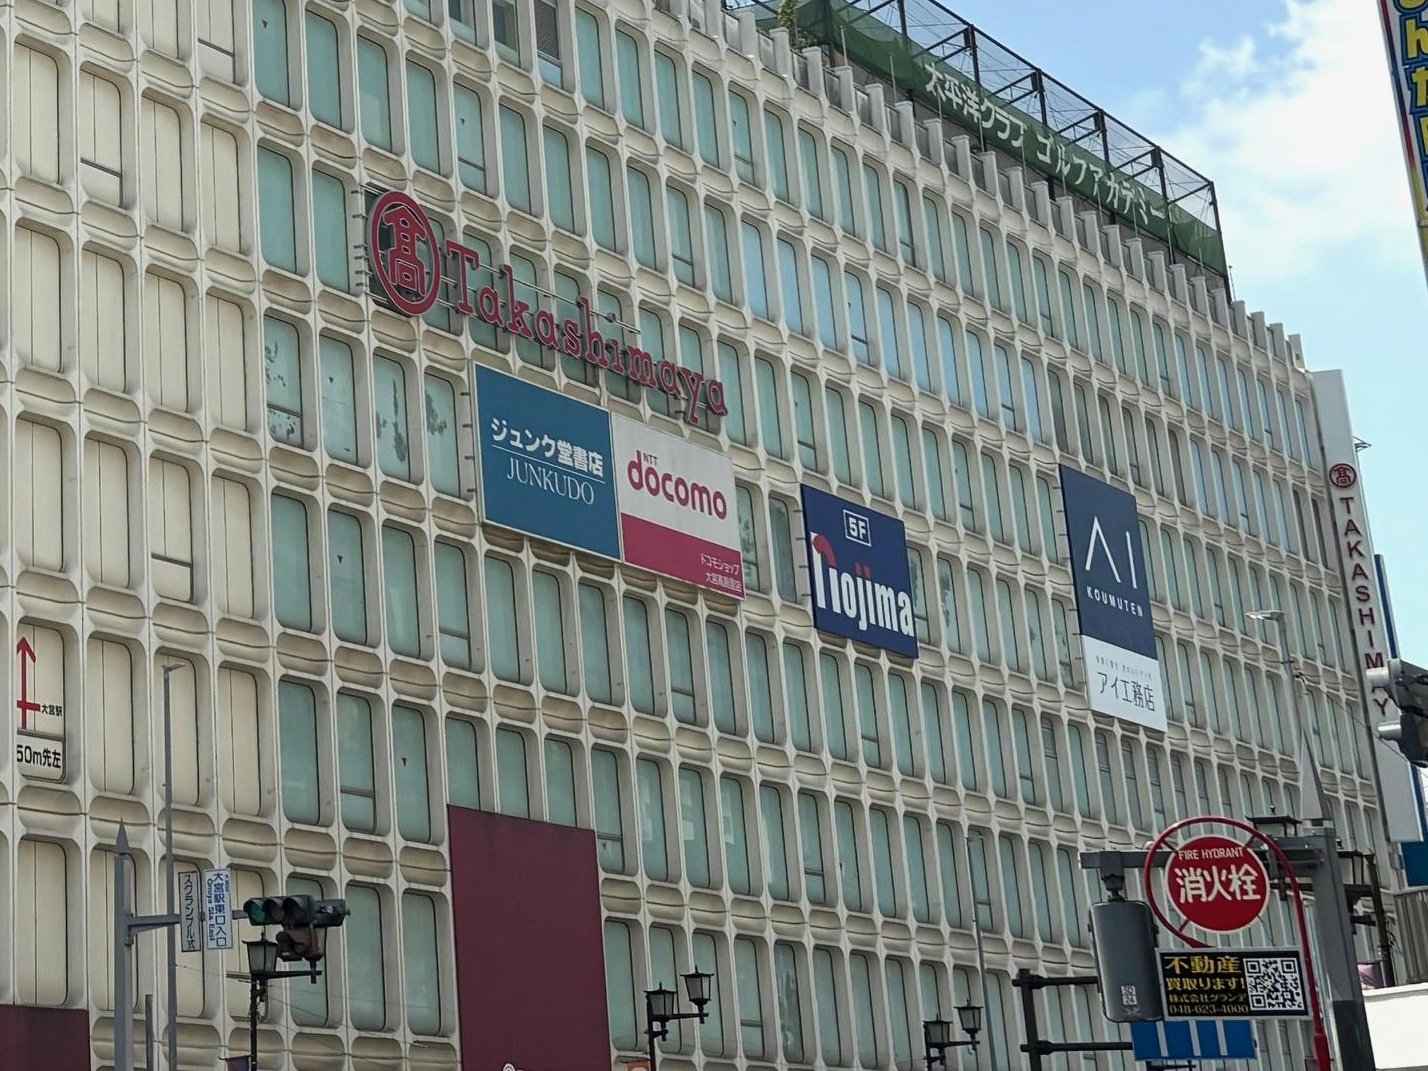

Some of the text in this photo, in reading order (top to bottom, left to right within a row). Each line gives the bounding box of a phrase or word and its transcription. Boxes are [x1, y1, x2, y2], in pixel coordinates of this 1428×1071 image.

[445, 239, 730, 425] Takashimaya
[490, 416, 605, 478] ジュンク堂書店
[642, 451, 659, 466] NTT
[506, 457, 595, 505] JUNKUDO
[627, 450, 728, 520] docomo
[848, 517, 867, 540] 5F
[1084, 515, 1138, 590] AI
[1086, 585, 1144, 618] KOUMUTEN
[1339, 496, 1390, 717] TAKASHIMY
[1097, 671, 1157, 712] アイ工務店
[16, 744, 62, 770] 50m先左
[1178, 846, 1244, 861] FIRE HYDRANT
[1174, 863, 1262, 904] 消火栓
[213, 873, 227, 947] 大宮駅東口入口
[1164, 955, 1242, 975] 不動産
